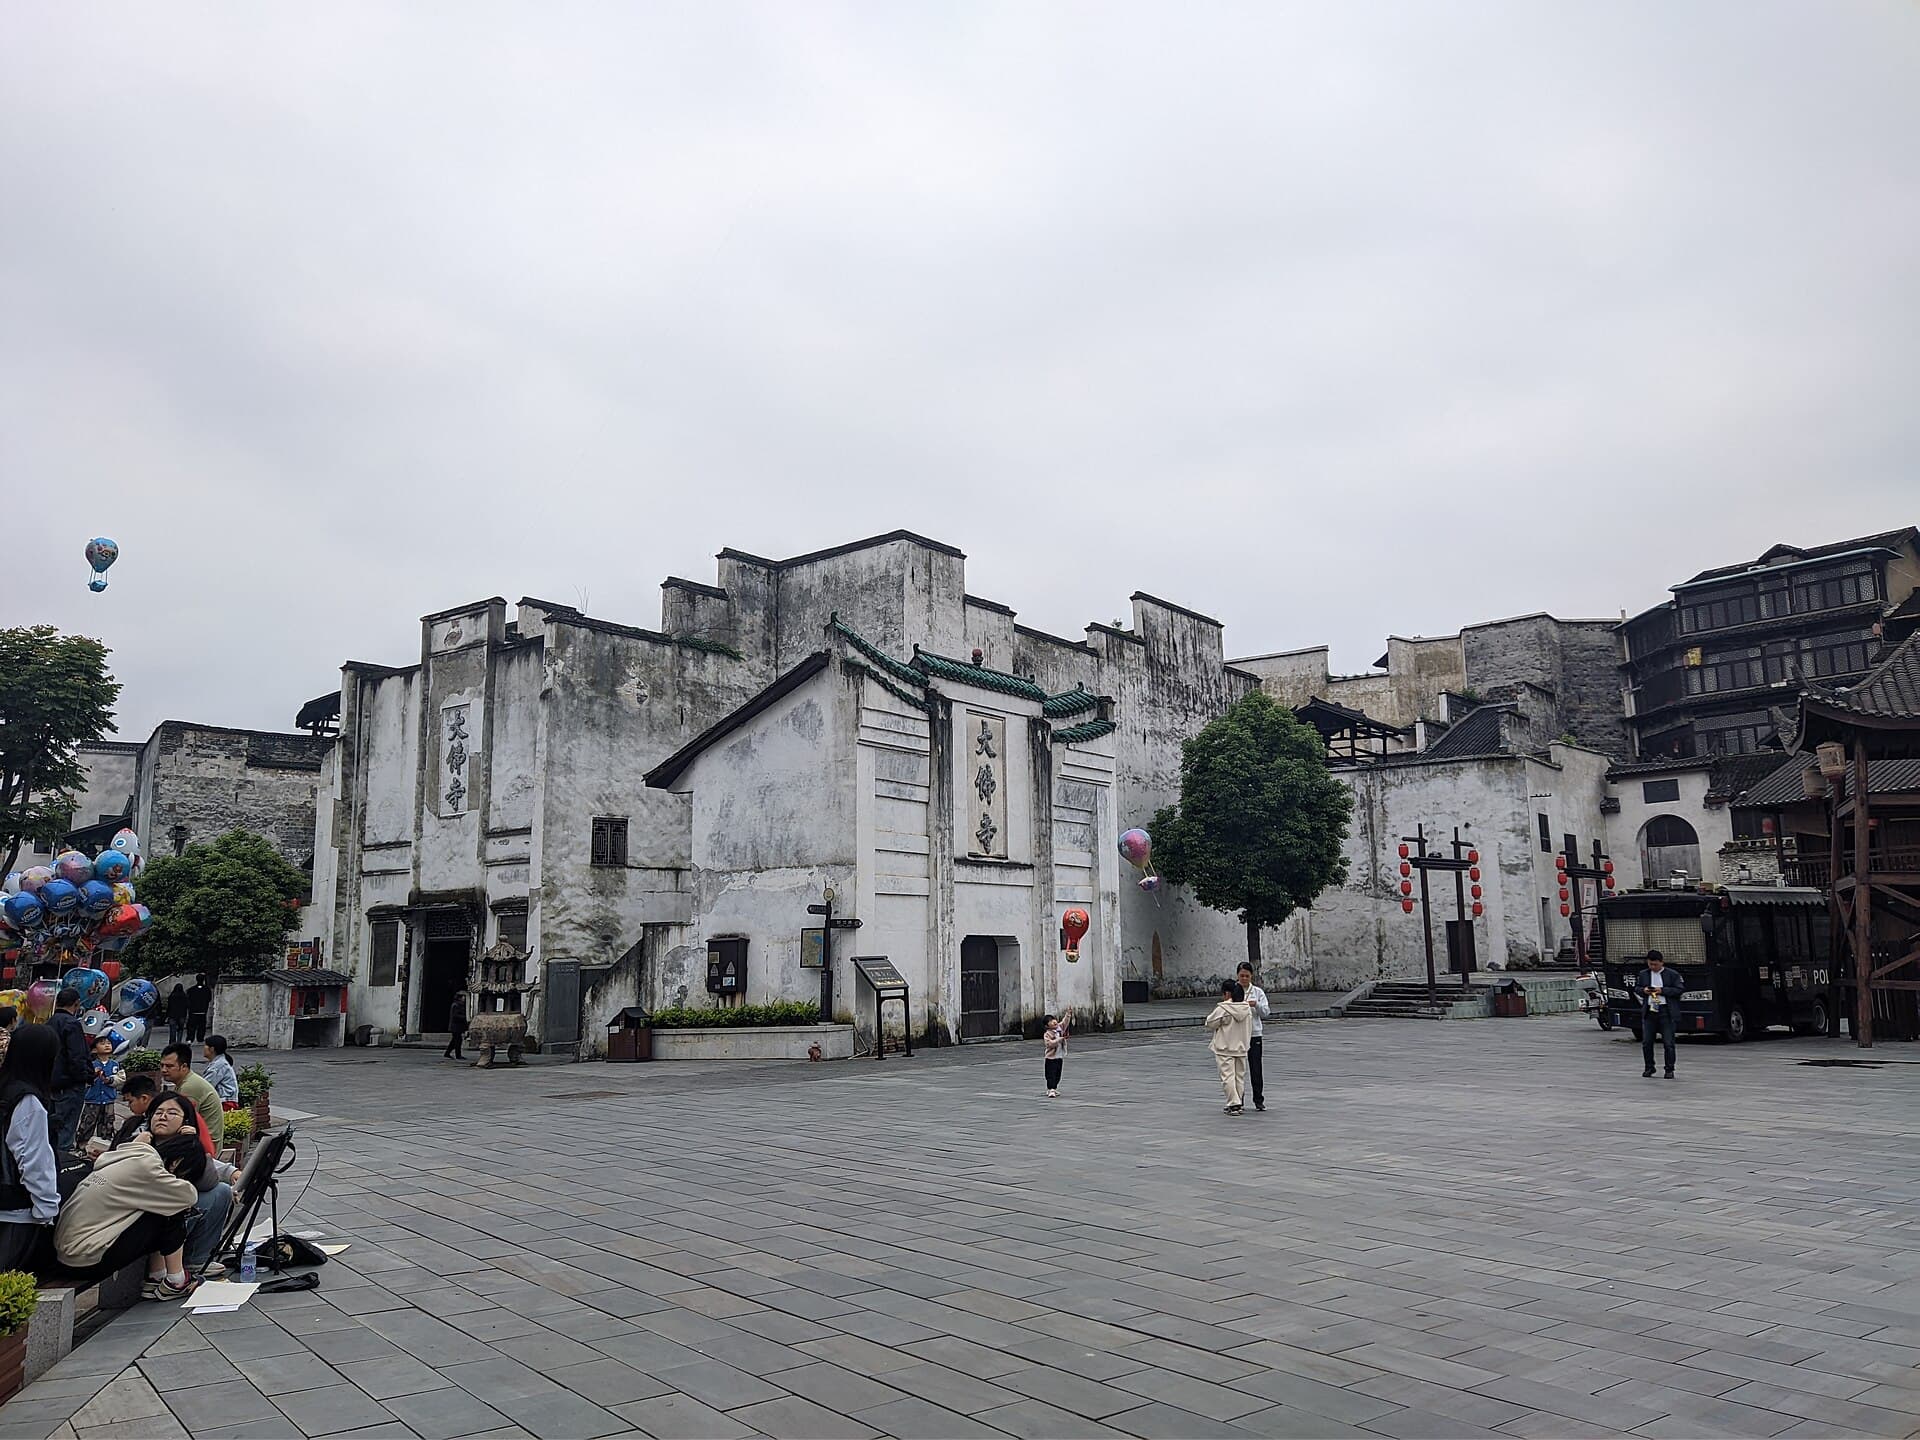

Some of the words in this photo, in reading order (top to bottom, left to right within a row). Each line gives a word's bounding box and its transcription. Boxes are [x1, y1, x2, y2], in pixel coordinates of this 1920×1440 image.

[446, 709, 469, 812] 大佛寺
[974, 719, 998, 855] 大佛寺
